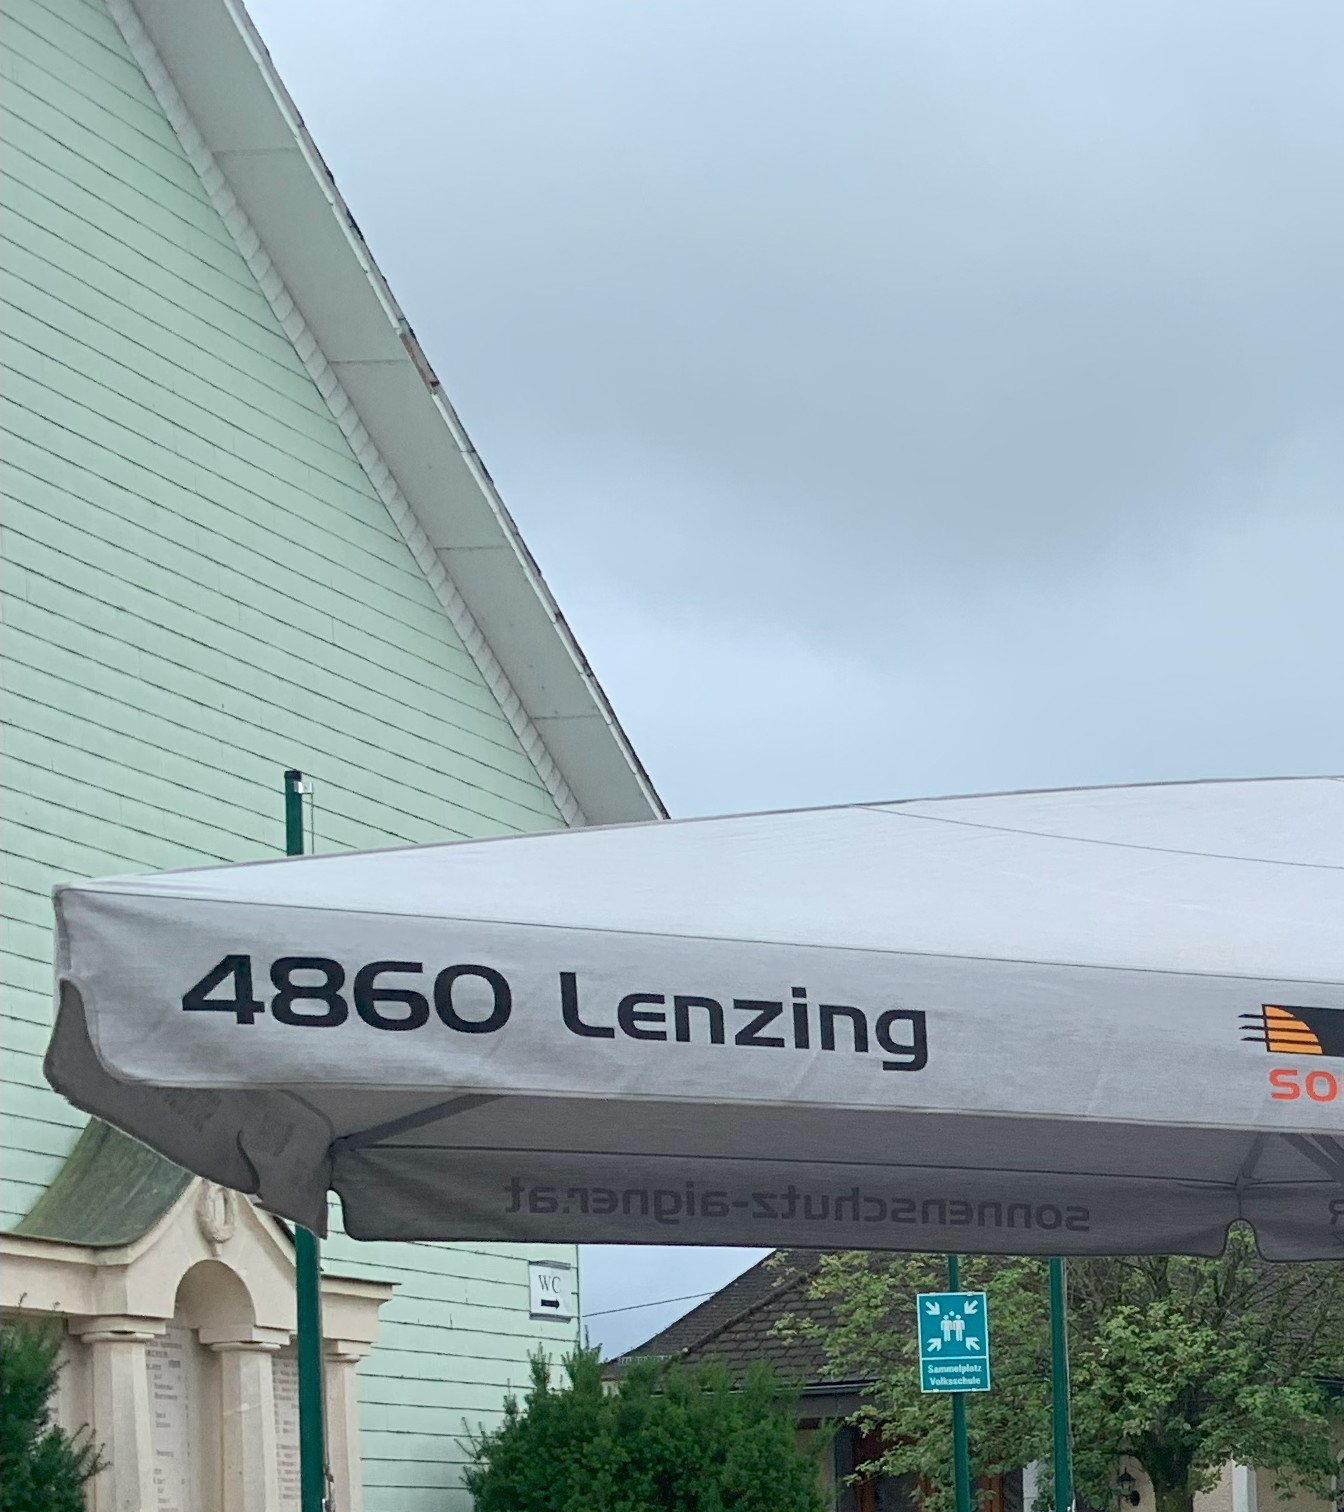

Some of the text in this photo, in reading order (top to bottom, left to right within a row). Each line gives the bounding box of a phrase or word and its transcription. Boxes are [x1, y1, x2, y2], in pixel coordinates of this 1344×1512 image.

[181, 954, 928, 1072] 4860 Lenzing
[538, 1274, 561, 1294] WC
[927, 1364, 982, 1374] Sammelplatz
[929, 1376, 981, 1385] Volksschule
